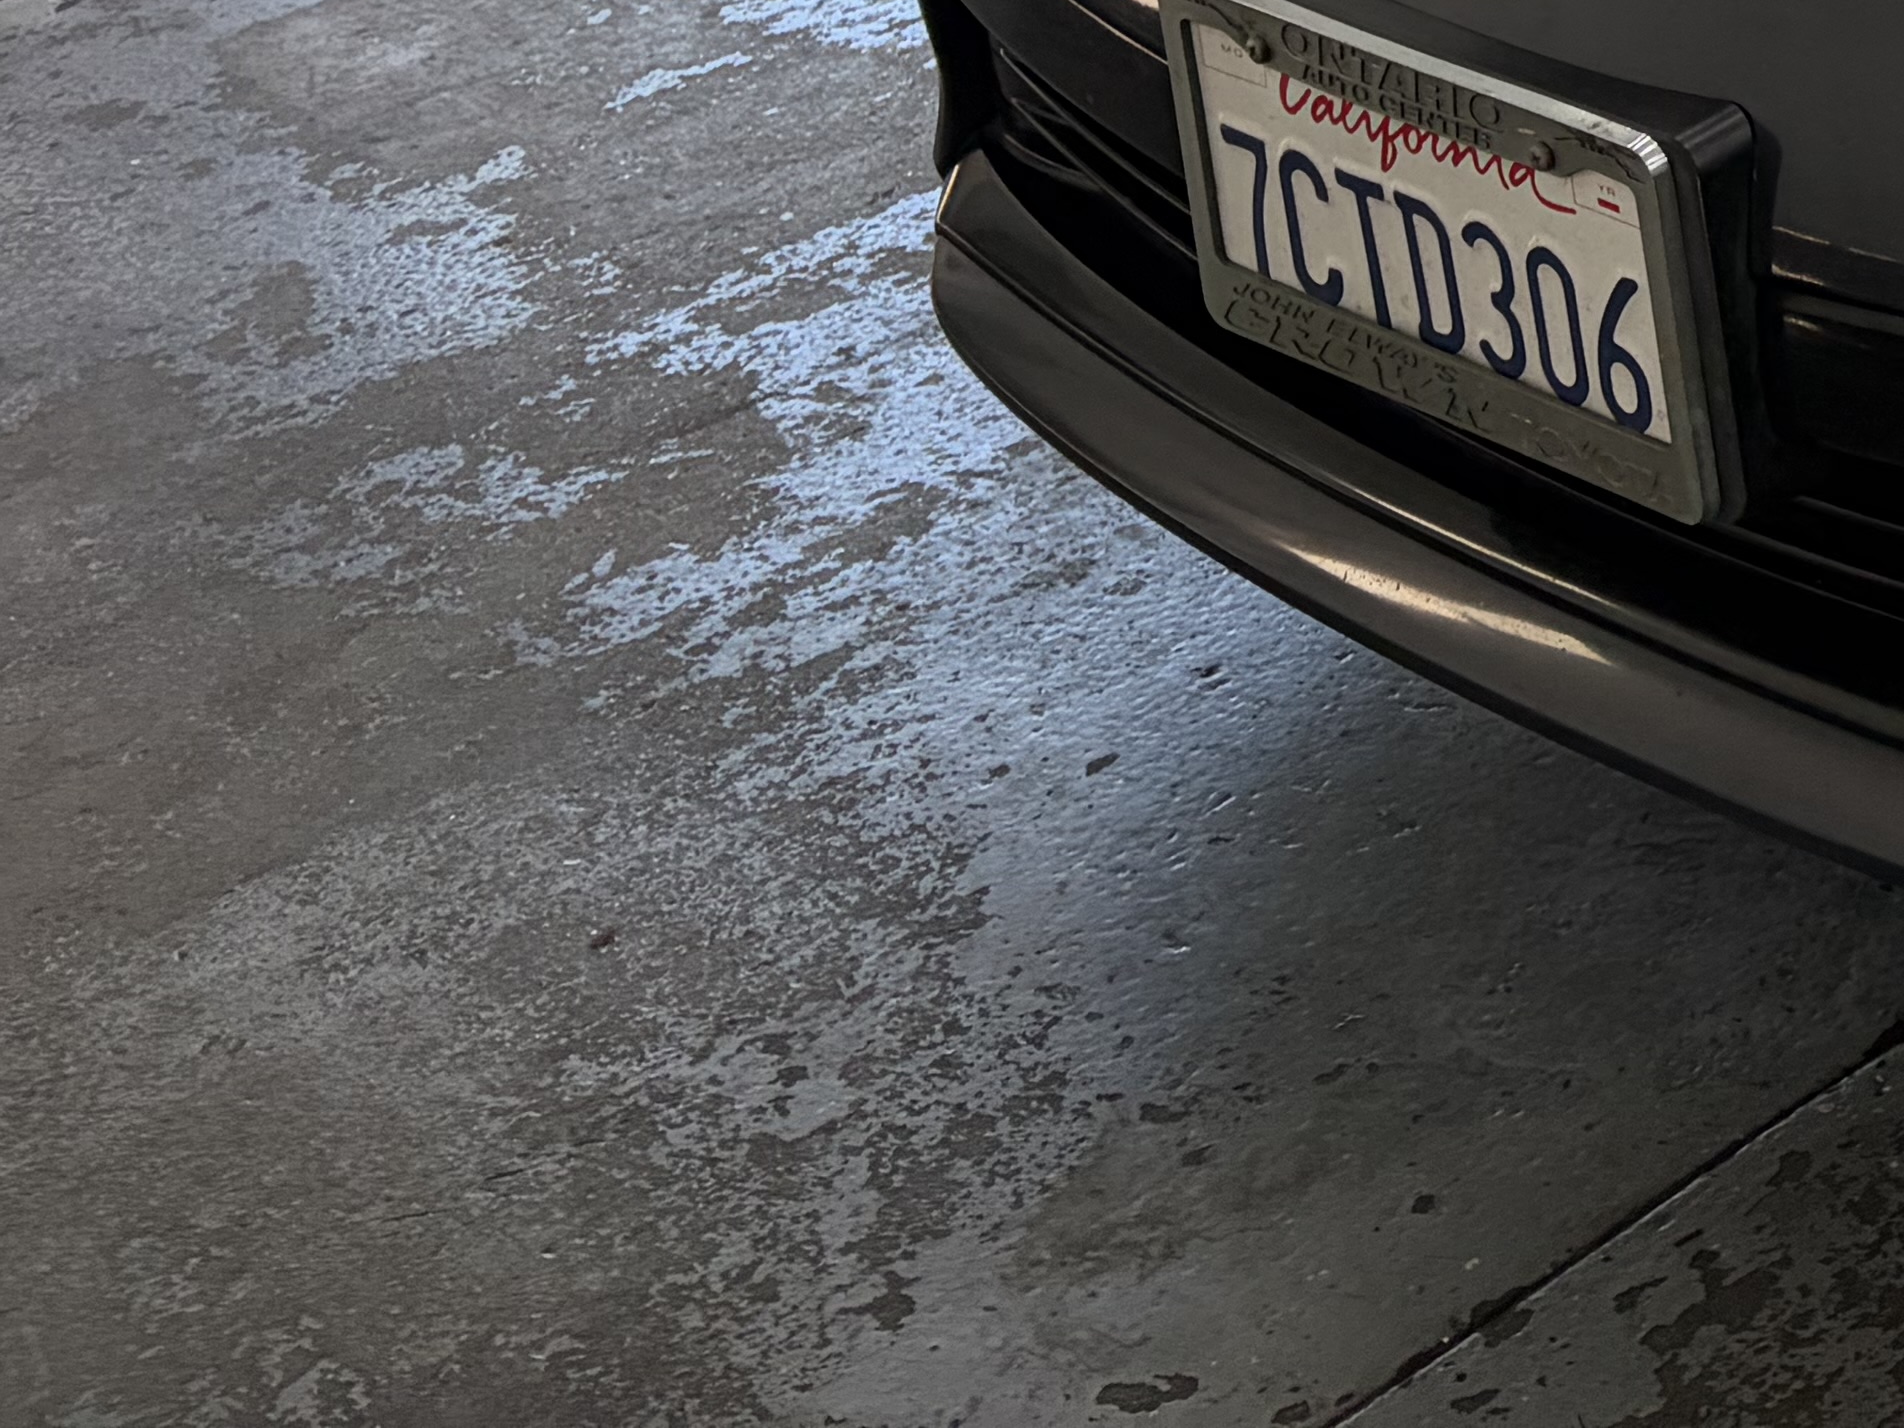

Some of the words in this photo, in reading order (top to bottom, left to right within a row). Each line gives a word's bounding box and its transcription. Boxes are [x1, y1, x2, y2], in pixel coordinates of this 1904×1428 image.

[1280, 22, 1504, 133] ONTARIO
[1303, 64, 1369, 102] AUTO
[1219, 123, 1654, 436] 7CTD306
[1232, 282, 1316, 325] JOHN
